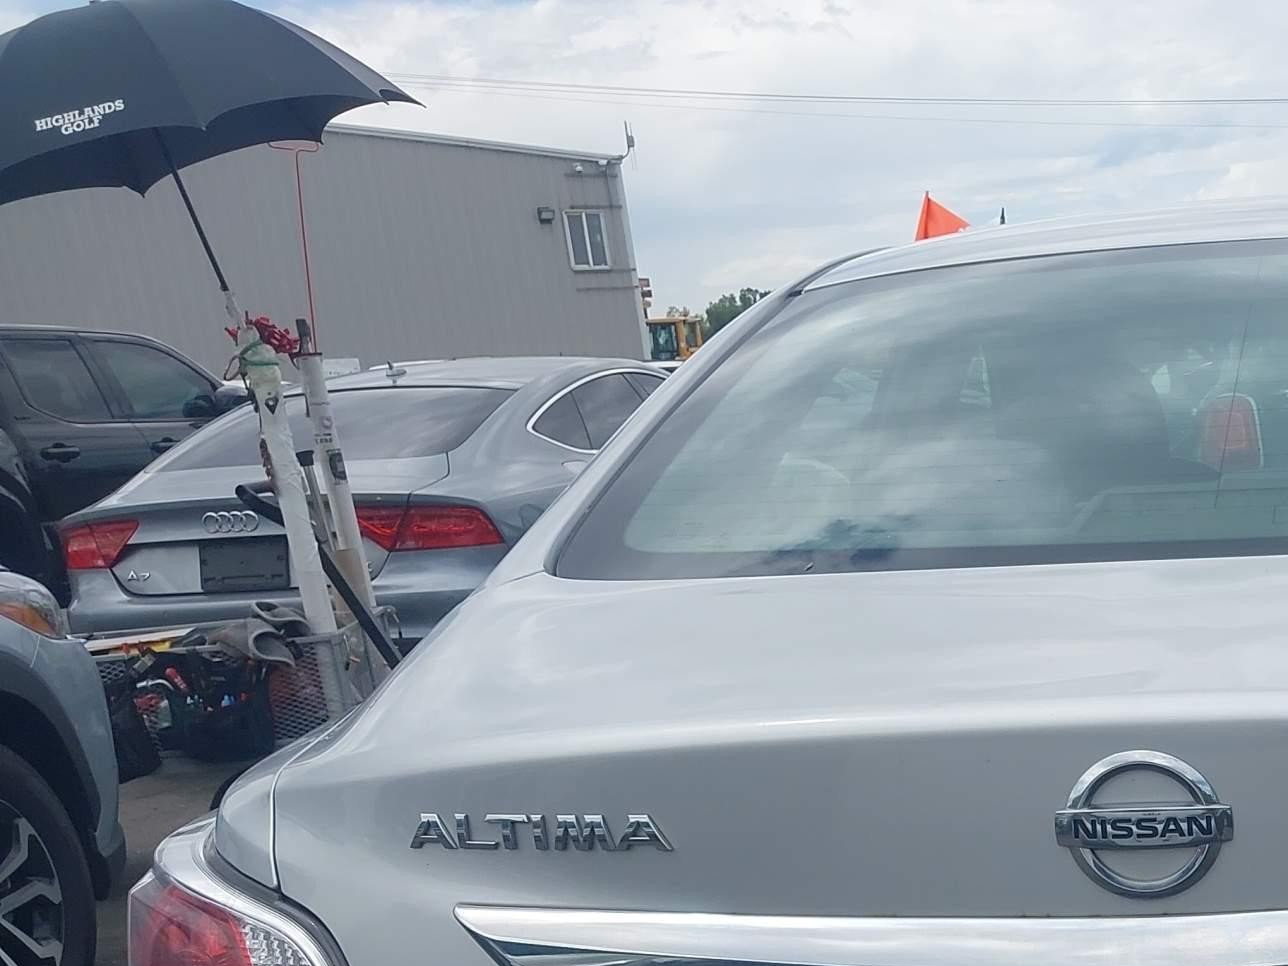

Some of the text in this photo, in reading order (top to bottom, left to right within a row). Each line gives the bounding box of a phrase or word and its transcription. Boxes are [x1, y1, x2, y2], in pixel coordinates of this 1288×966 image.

[34, 99, 125, 131] HIGHLANDS
[61, 116, 103, 135] GOLF
[127, 569, 151, 582] A7
[410, 811, 675, 852] ALTIMA
[1072, 814, 1213, 840] NISSAN
